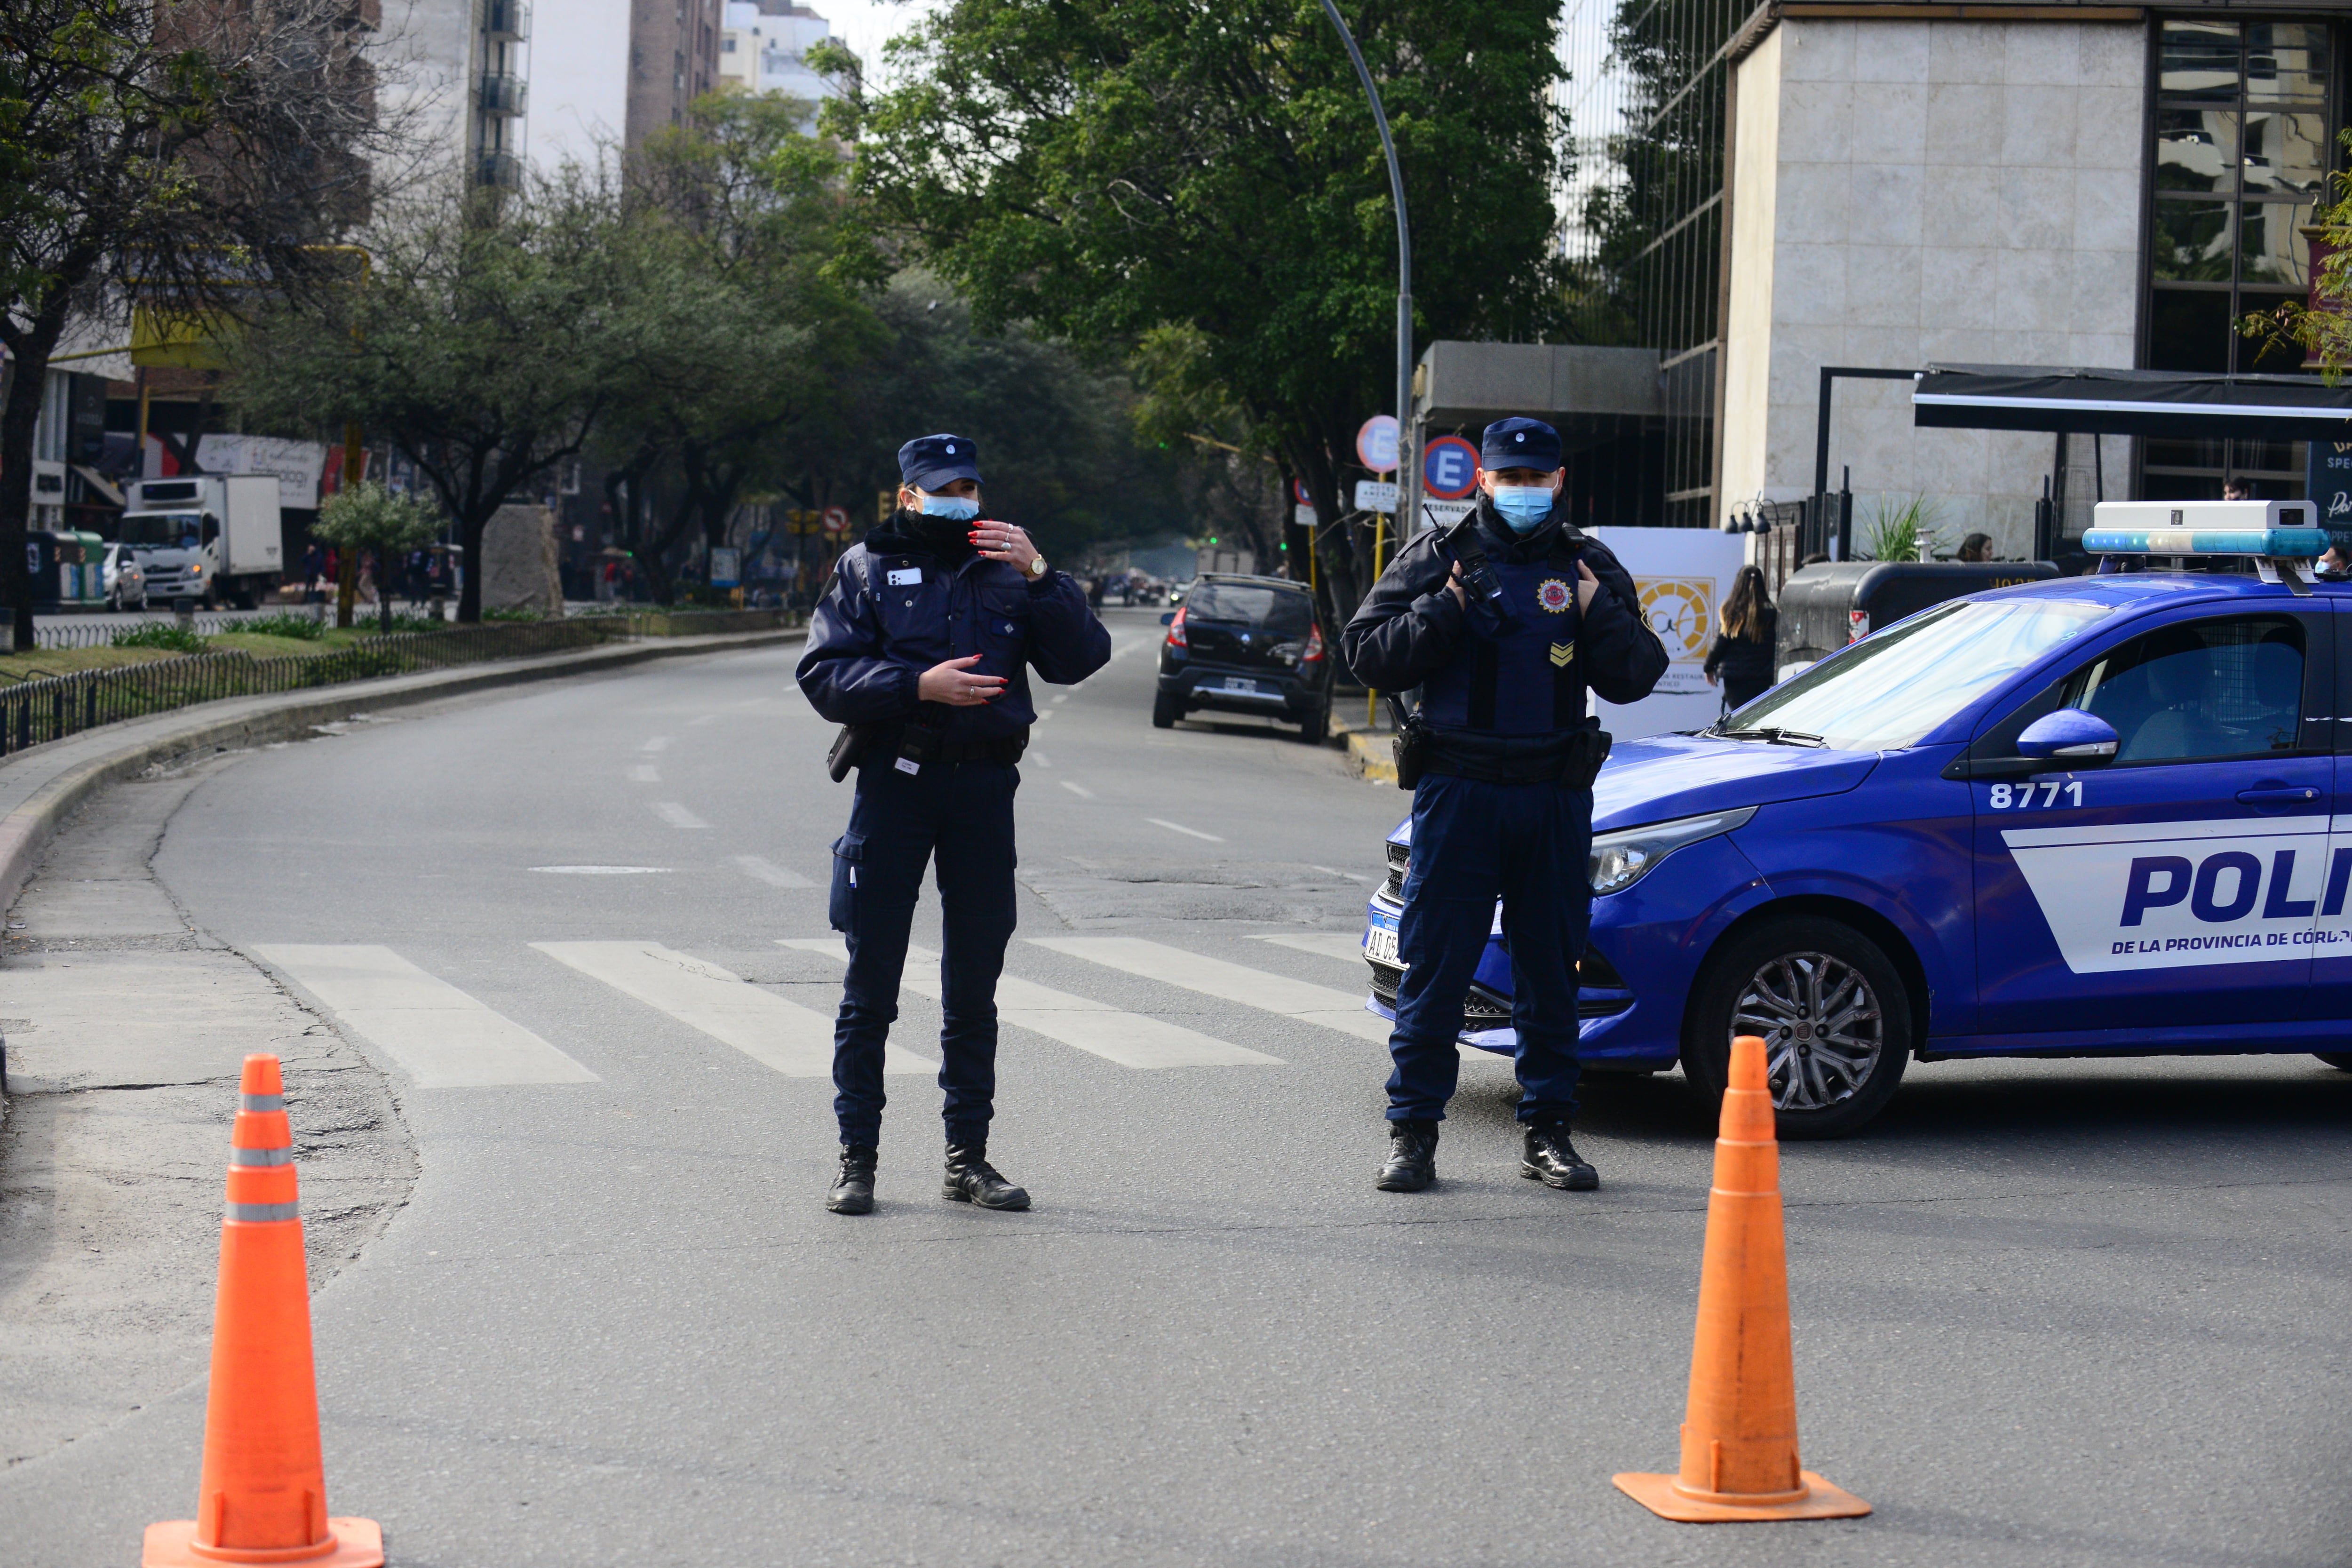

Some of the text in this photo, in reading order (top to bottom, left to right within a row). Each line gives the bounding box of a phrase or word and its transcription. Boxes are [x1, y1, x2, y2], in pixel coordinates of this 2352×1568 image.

[1372, 429, 1393, 460] E
[1436, 450, 1463, 487] E
[2328, 457, 2352, 469] SPE
[1990, 781, 2082, 809] 8771
[2111, 941, 2135, 954] DE
[2139, 939, 2161, 953] LA
[2165, 934, 2262, 951] PROVINCIA
[2266, 932, 2288, 946] DE
